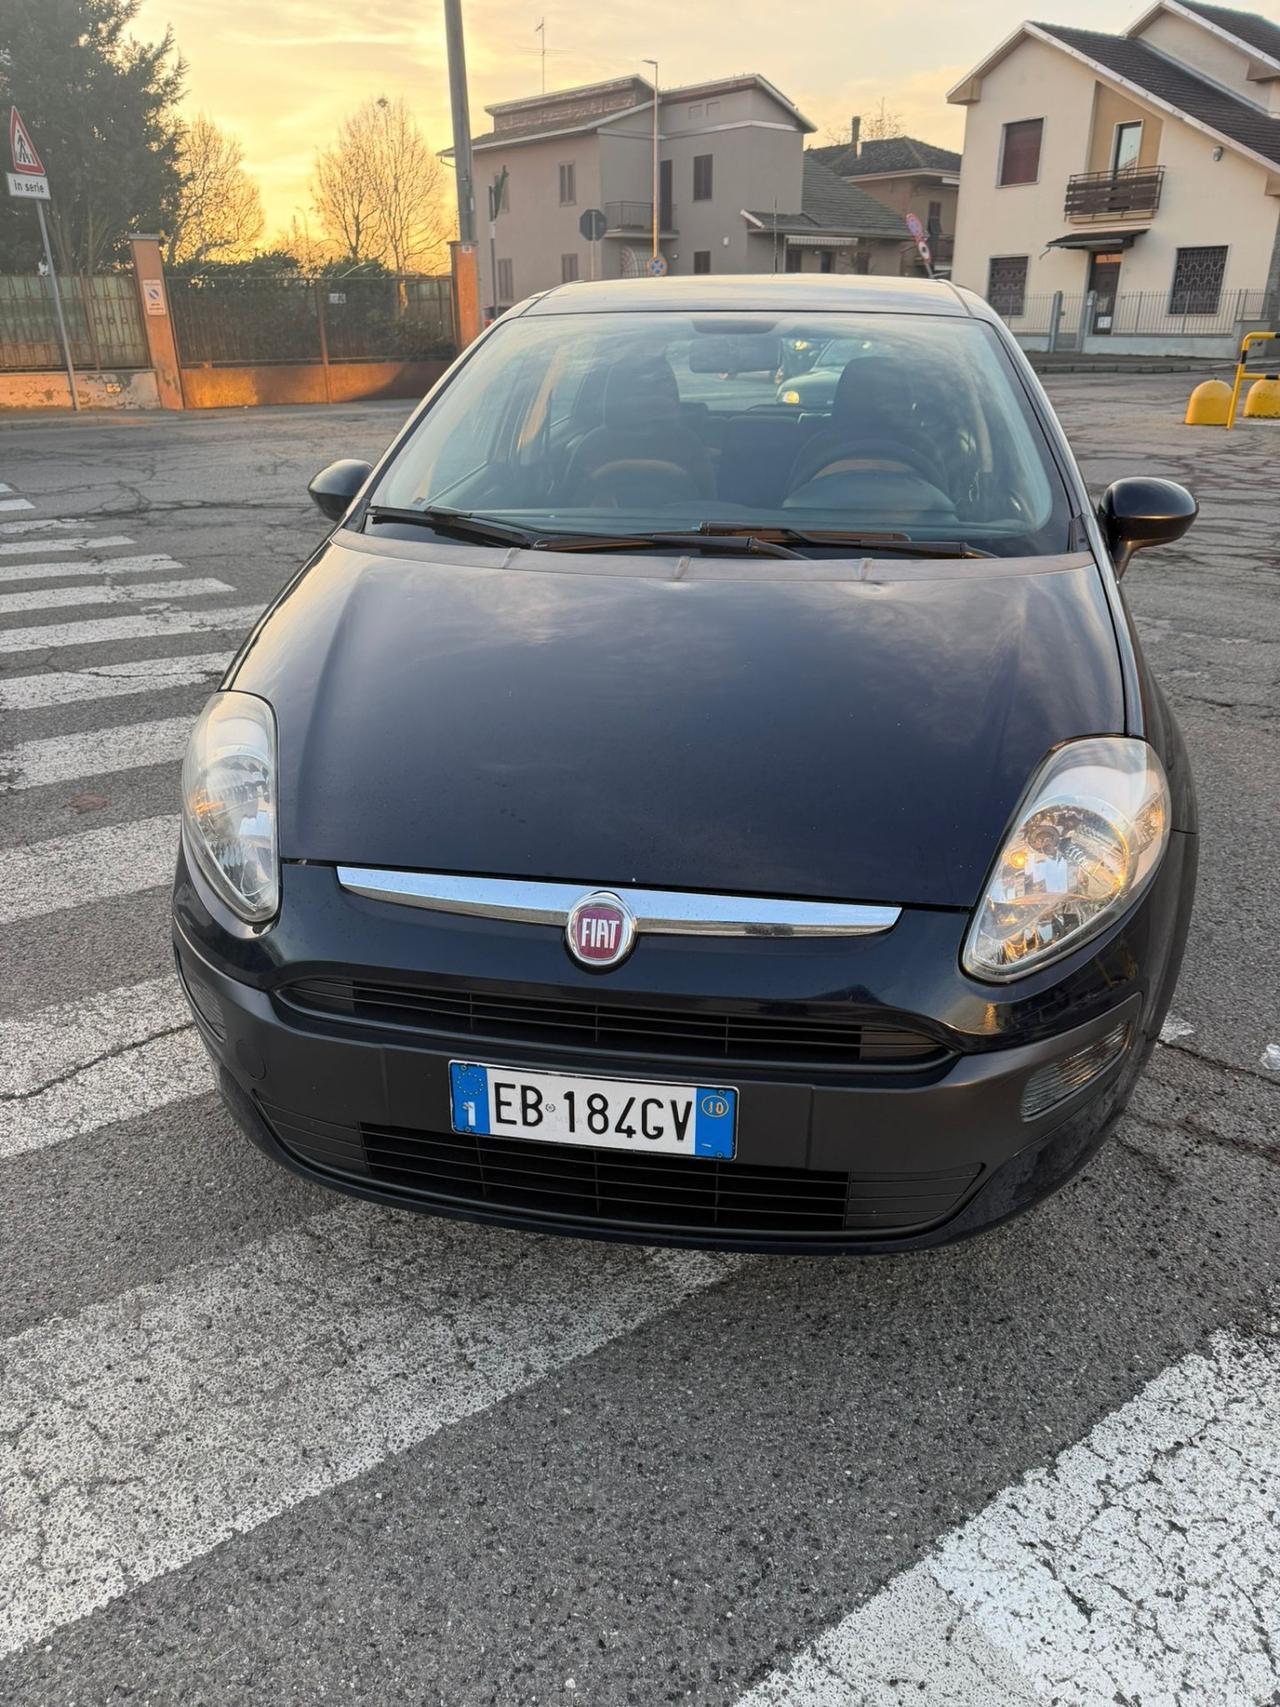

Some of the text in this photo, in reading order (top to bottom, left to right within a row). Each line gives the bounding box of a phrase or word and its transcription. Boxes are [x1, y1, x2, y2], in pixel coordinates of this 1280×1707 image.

[25, 182, 45, 193] serie
[581, 918, 620, 949] FIAT
[494, 1082, 693, 1141] EB 184GV
